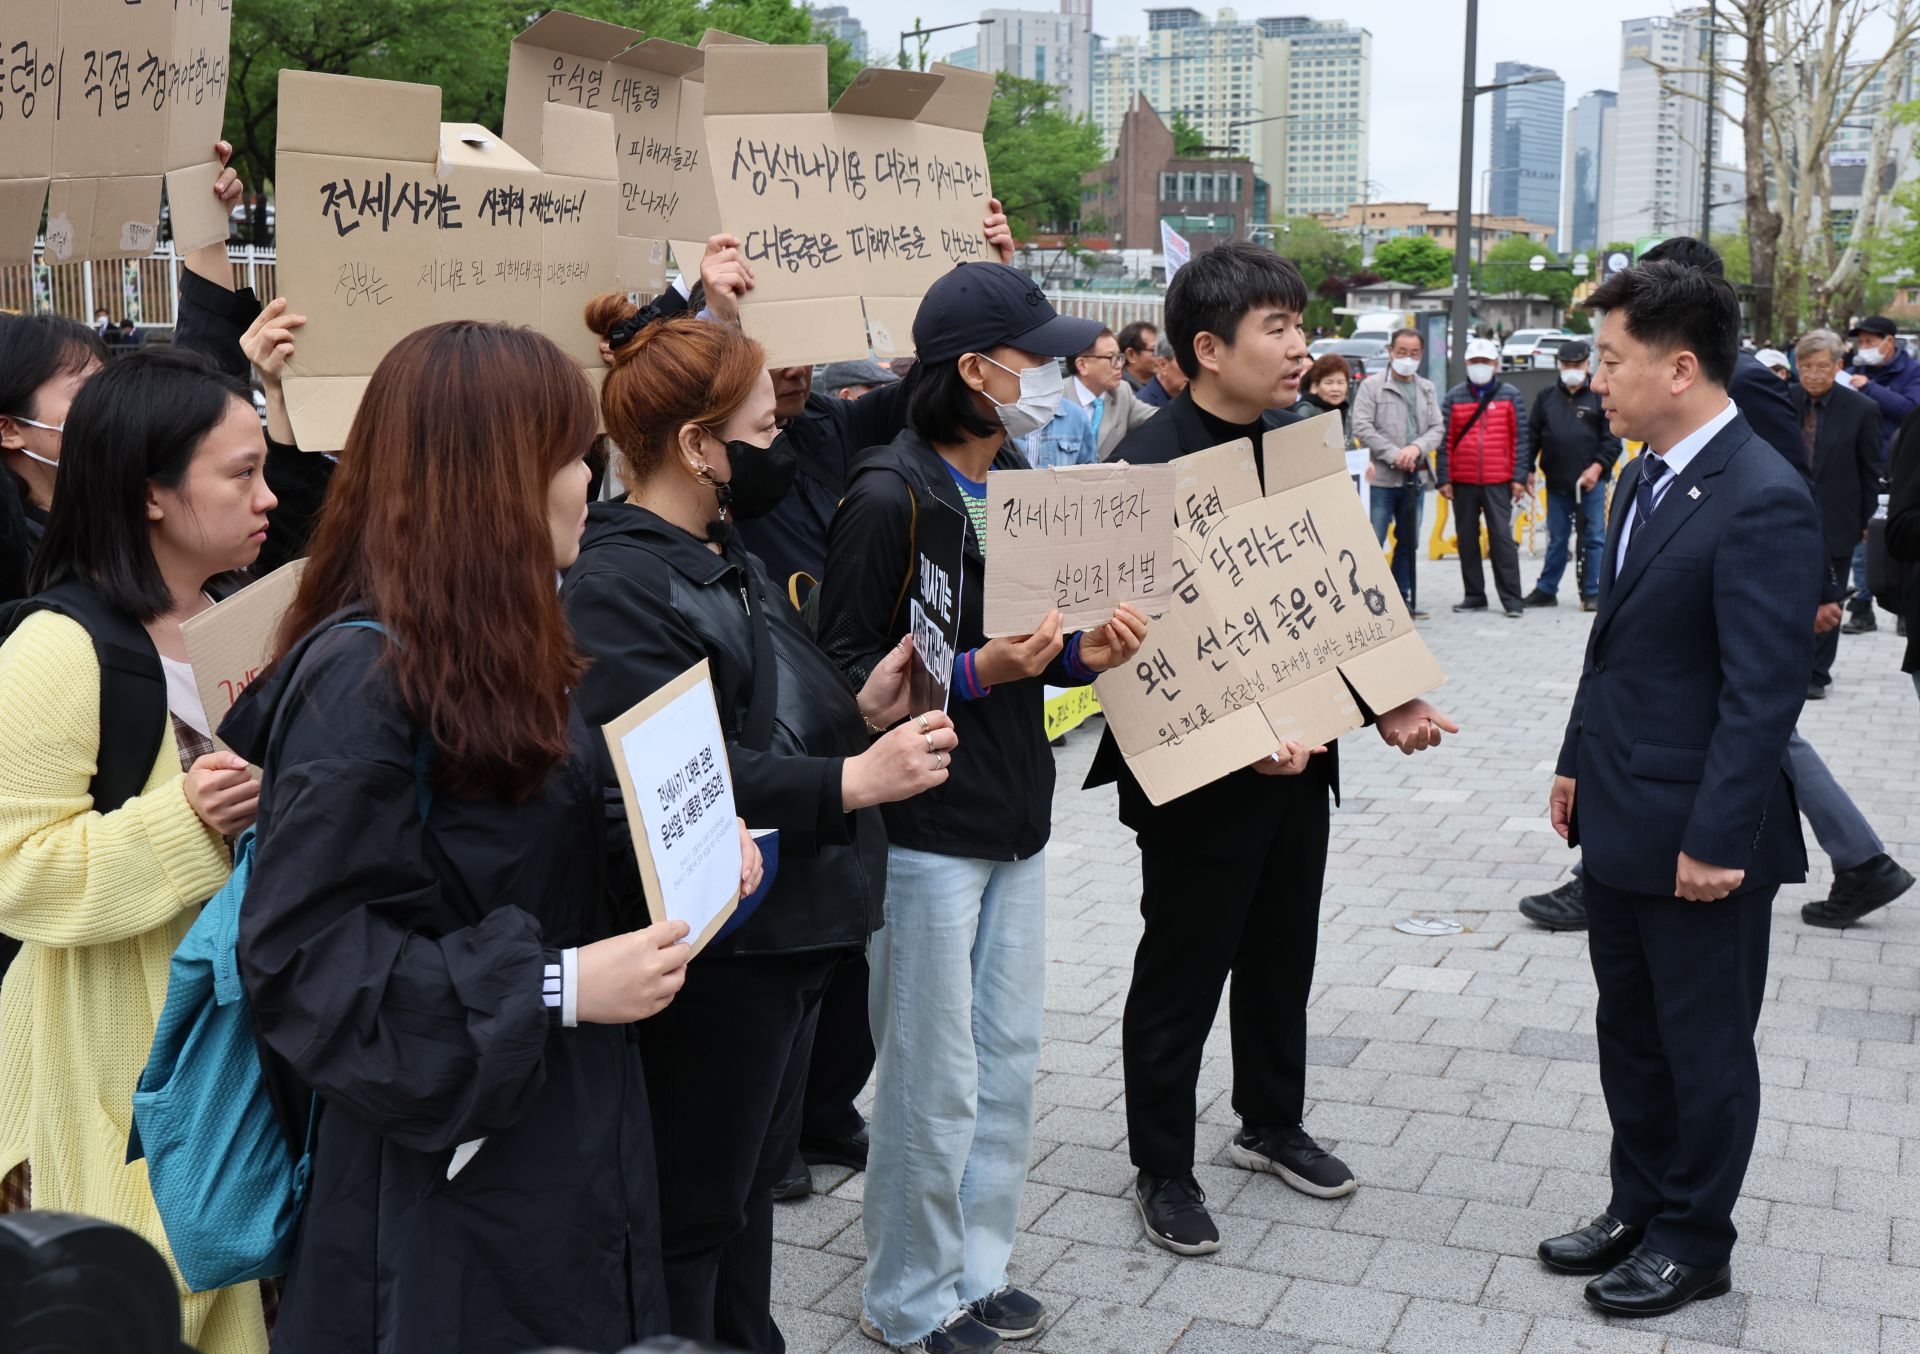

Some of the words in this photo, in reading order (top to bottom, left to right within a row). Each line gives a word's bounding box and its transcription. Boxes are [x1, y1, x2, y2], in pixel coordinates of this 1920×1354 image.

[0, 41, 64, 120] 령이
[84, 50, 131, 117] 직접
[547, 57, 603, 108] 윤석열
[611, 78, 660, 114] 대통령
[628, 136, 698, 172] 피해자들과
[731, 136, 867, 200] 생색내기용
[875, 147, 921, 199] 대책
[320, 172, 463, 237] 전세사기는
[477, 184, 525, 228] 사회적
[529, 189, 587, 224] 재난이다!
[622, 182, 679, 223] 만나자!!
[745, 223, 843, 273] 대통령은
[846, 223, 932, 263] 피해자들을
[334, 261, 393, 307] 정부는
[1003, 493, 1084, 538] 전세사기
[1093, 488, 1151, 532] 가담자
[1186, 486, 1224, 538] 돌려
[1210, 507, 1327, 588] 달라는데
[1054, 557, 1110, 608] 살인죄
[1118, 550, 1156, 594] 처벌
[1136, 648, 1181, 701] 왠
[1197, 606, 1271, 672] 선순위
[1271, 648, 1311, 684] 요구사항
[1313, 638, 1345, 665] 읽어는
[657, 768, 688, 811] 전세사기
[684, 756, 702, 785] 대책
[661, 811, 685, 850] 윤석열
[682, 792, 703, 826] 대통령
